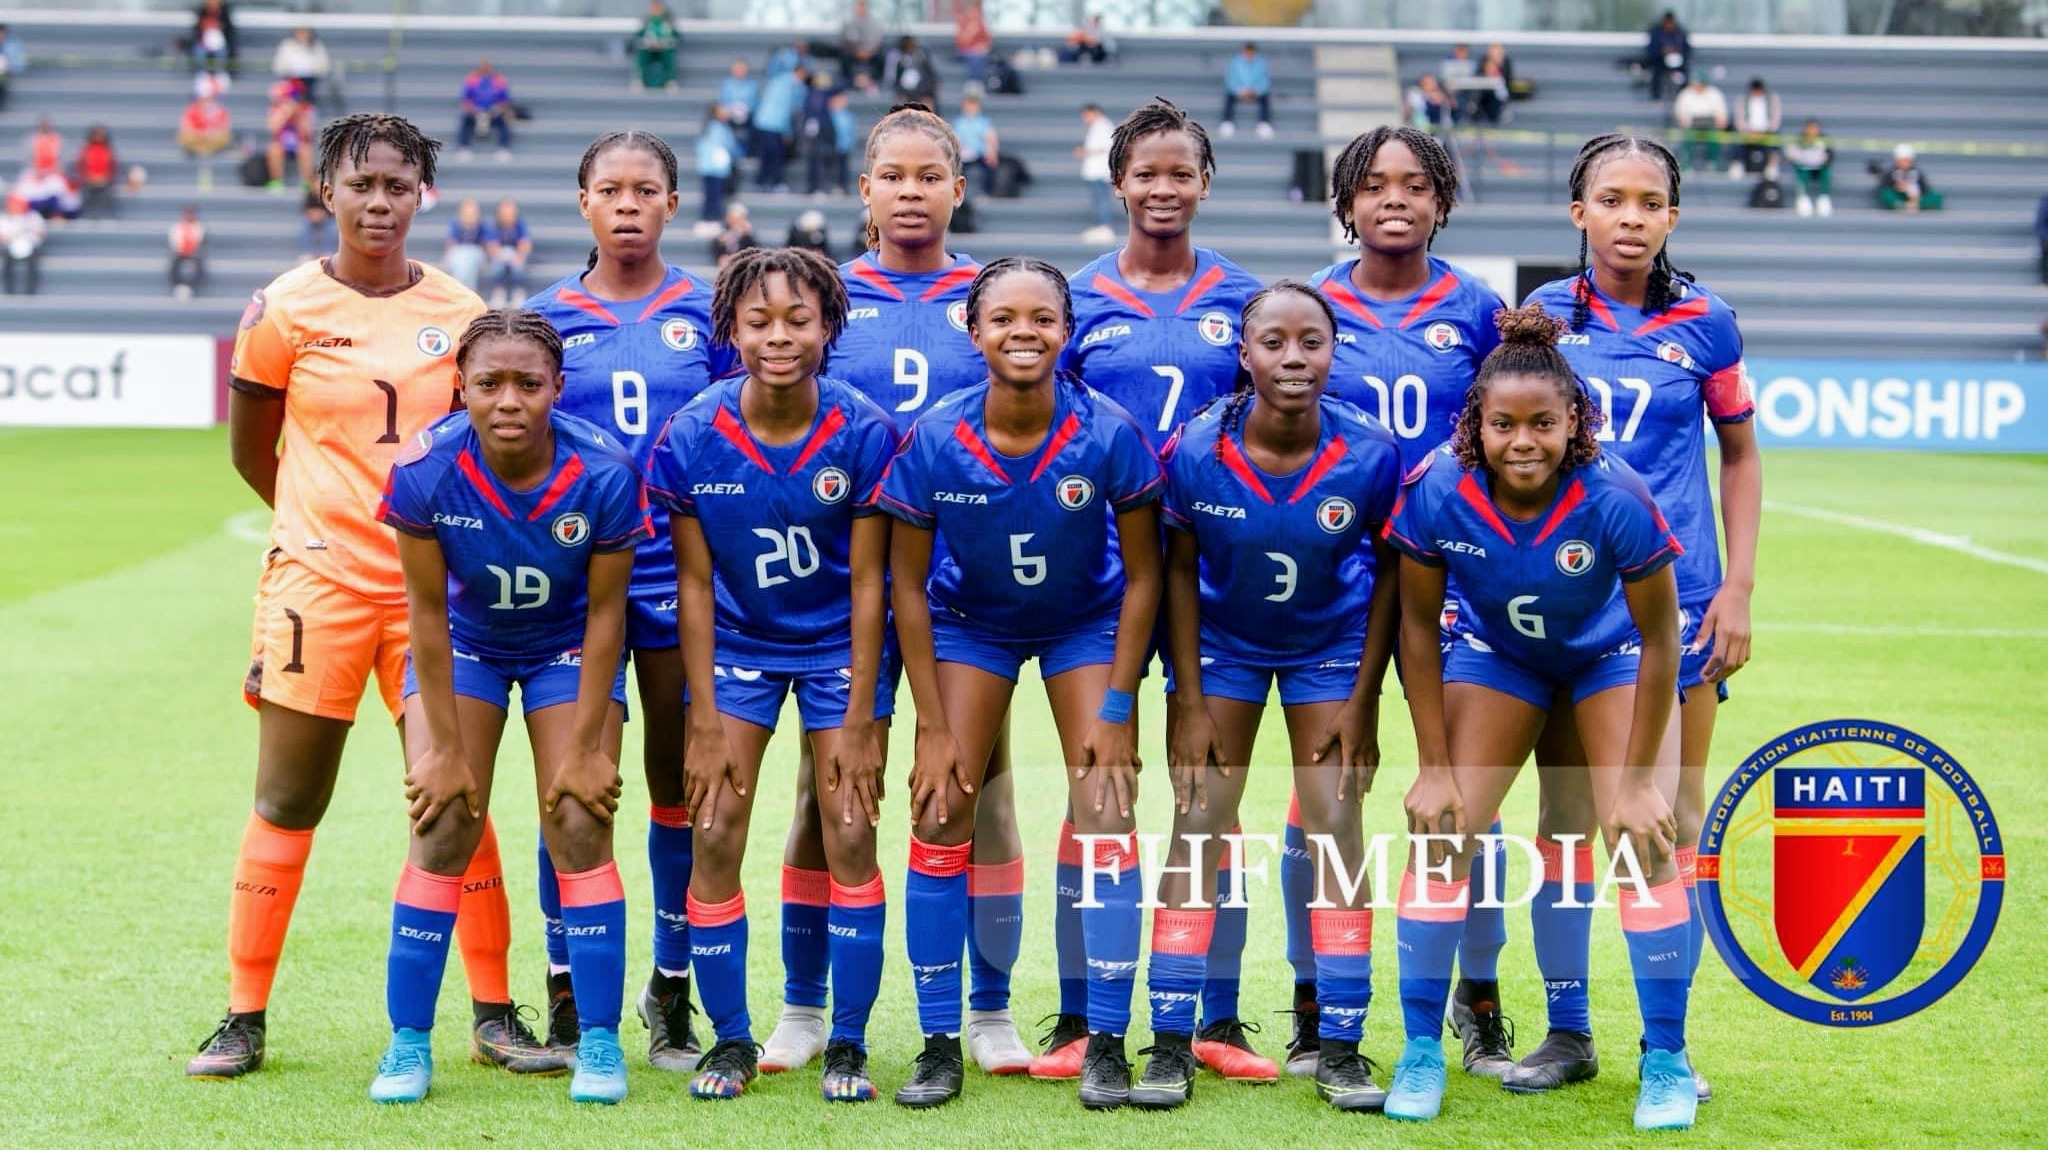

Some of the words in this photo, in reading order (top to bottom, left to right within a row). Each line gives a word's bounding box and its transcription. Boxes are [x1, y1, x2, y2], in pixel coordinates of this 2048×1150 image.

[847, 308, 879, 319] ETA
[1080, 315, 1131, 347] SAETA
[1558, 335, 1590, 346] ETA
[893, 349, 928, 411] 9
[1152, 366, 1184, 431] 7
[373, 380, 400, 443] 1
[612, 371, 647, 434] 8
[1362, 374, 1427, 438] 10
[1588, 377, 1652, 442] 17
[1751, 377, 2026, 439] ONSHIP
[690, 484, 745, 494] SAETA
[933, 491, 988, 504] SAETA
[1192, 502, 1246, 519] SAETA
[432, 513, 483, 530] SAETA
[752, 526, 819, 588] 20
[1010, 533, 1047, 586] 5
[1264, 552, 1297, 602] 3
[486, 564, 550, 609] 19
[1507, 595, 1546, 639] 6
[282, 608, 304, 673] 1
[398, 926, 442, 942] SAETA
[567, 925, 606, 936] SAETA
[691, 944, 731, 956] SAETA
[1544, 980, 1582, 989] AETA
